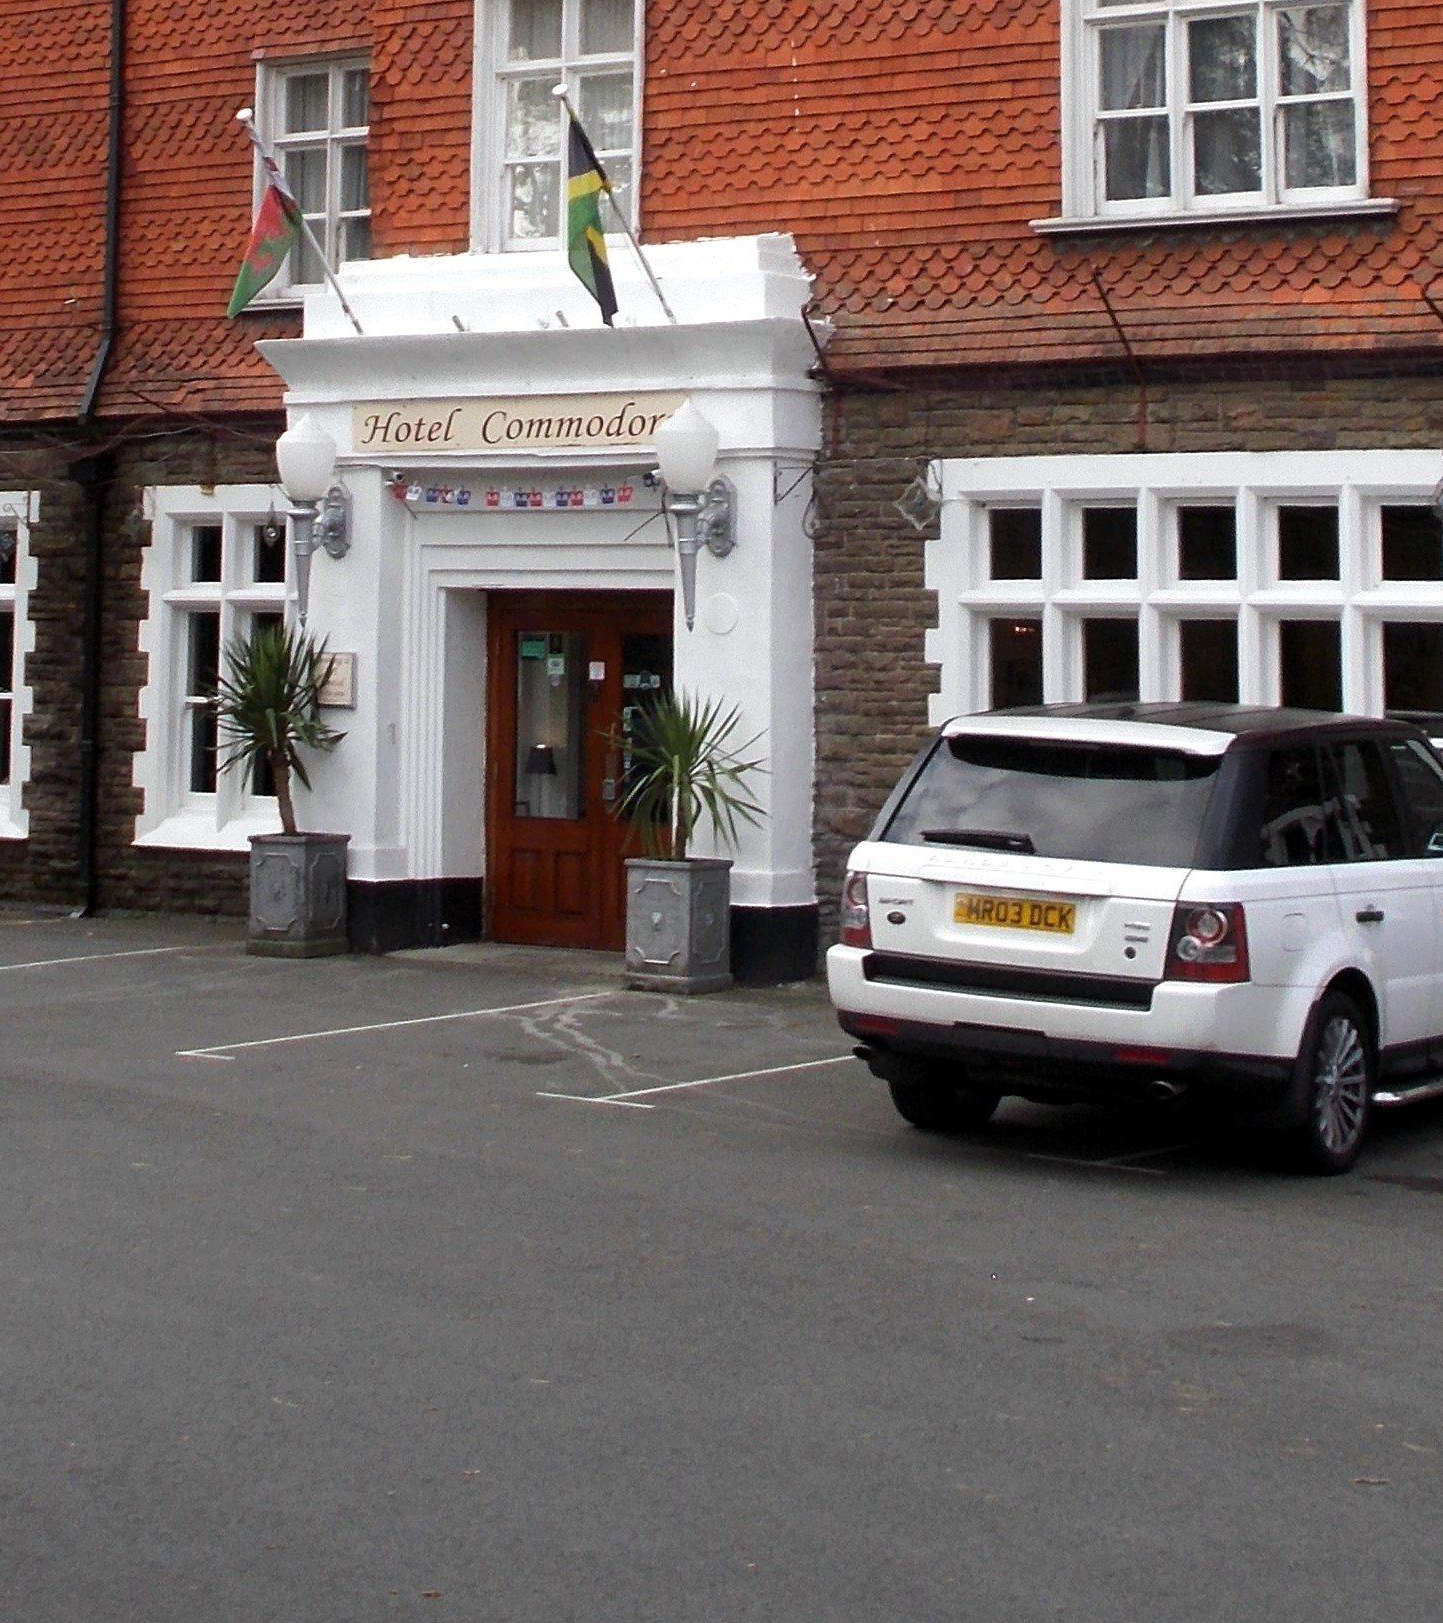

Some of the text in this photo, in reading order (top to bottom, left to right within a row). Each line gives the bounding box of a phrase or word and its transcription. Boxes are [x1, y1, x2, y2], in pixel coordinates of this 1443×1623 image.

[362, 402, 673, 444] Hotel Commodor
[1029, 904, 1073, 930] DCK
